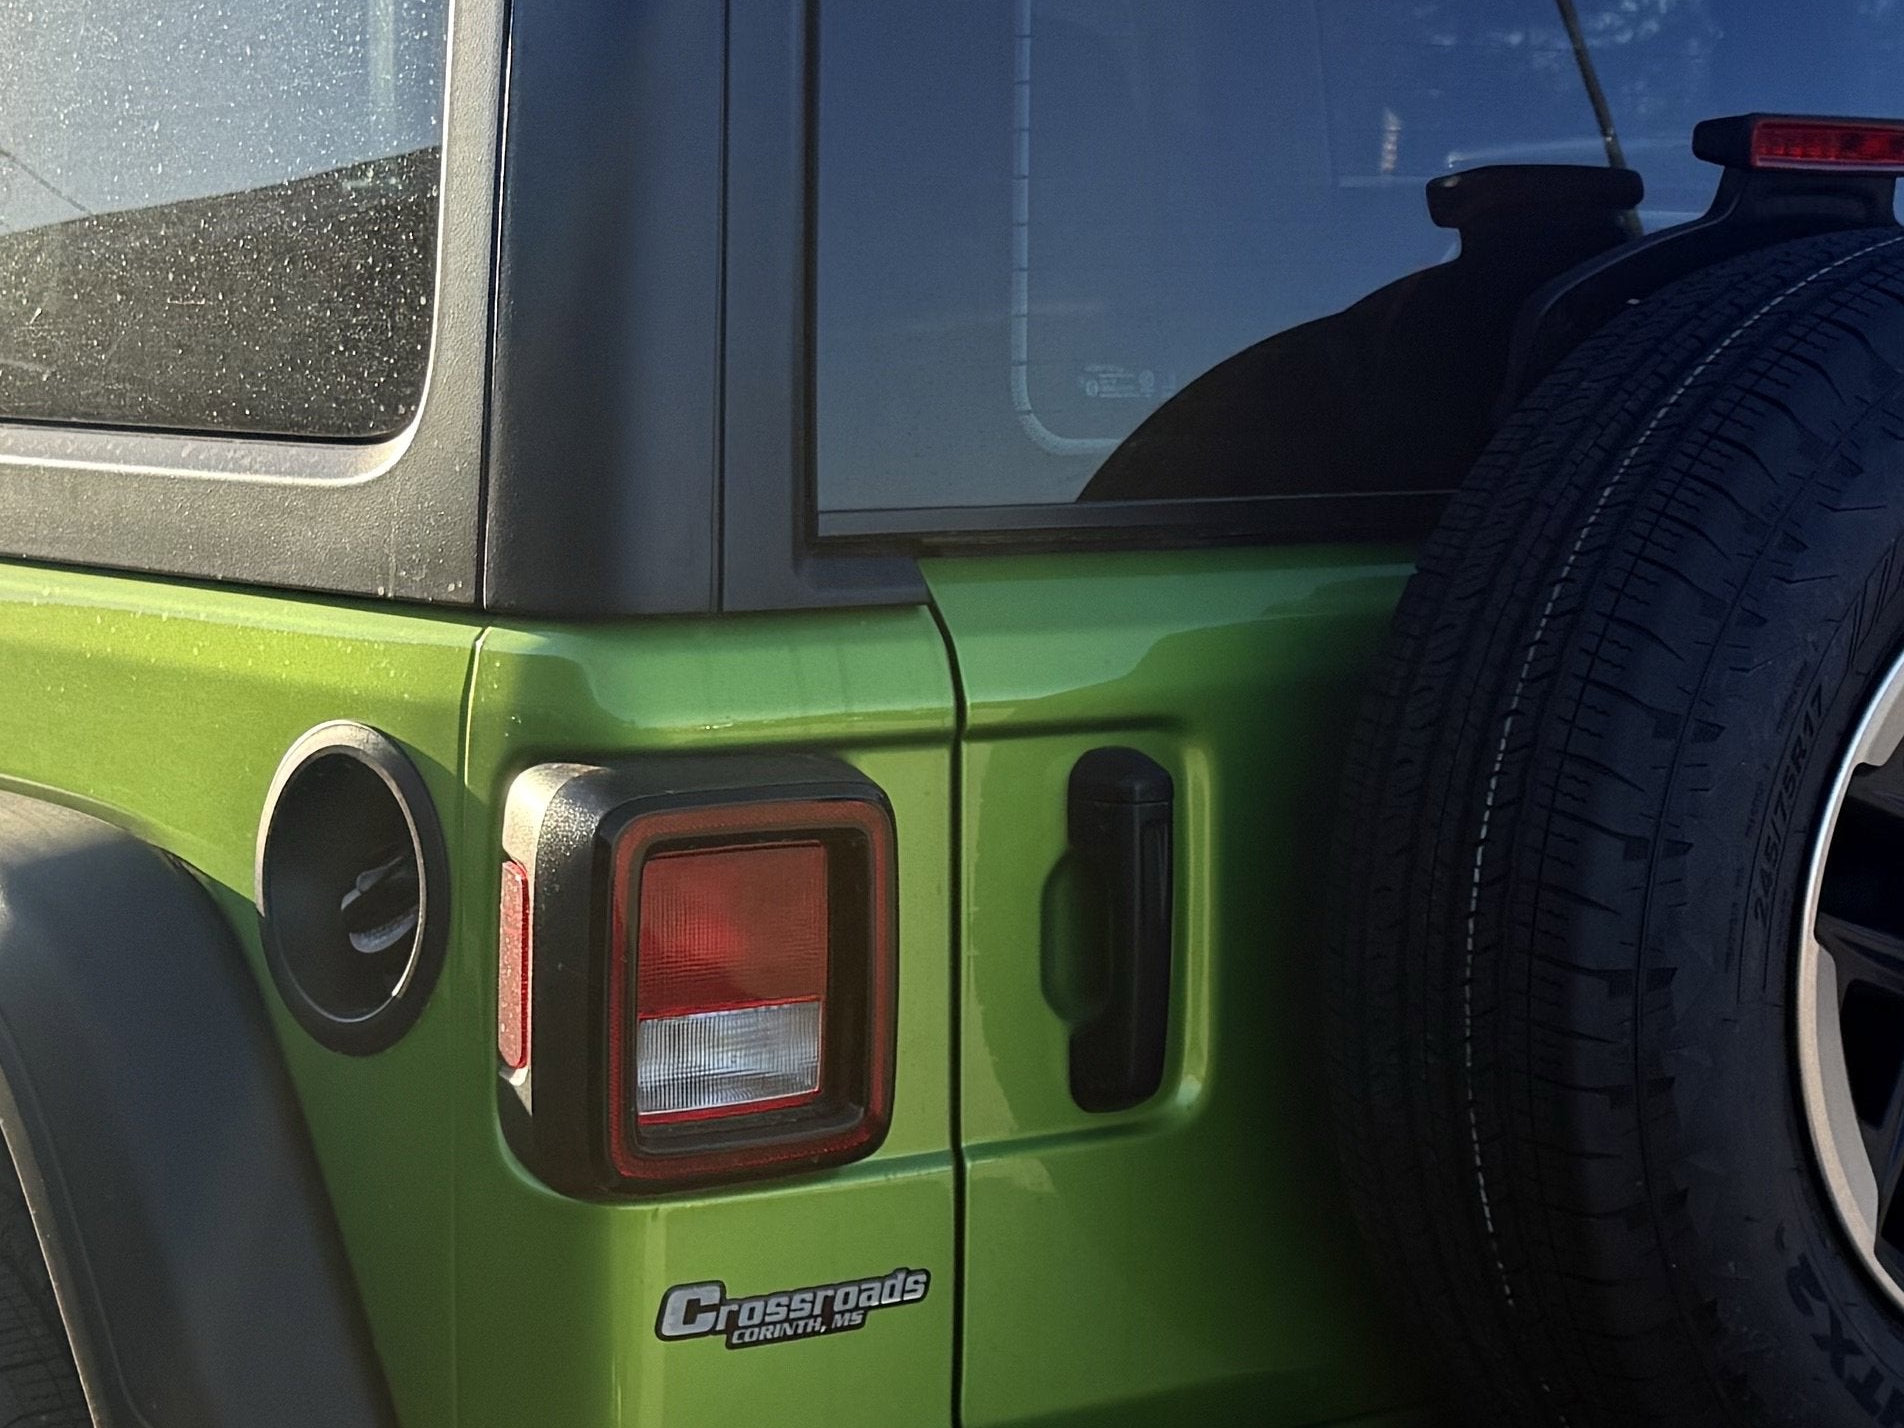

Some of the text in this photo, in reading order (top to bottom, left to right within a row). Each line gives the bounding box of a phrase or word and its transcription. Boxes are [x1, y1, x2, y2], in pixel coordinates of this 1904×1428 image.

[1753, 683, 1823, 929] 245/75R17
[660, 1269, 928, 1338] Crossroads
[731, 1310, 866, 1344] CORINTH, MS
